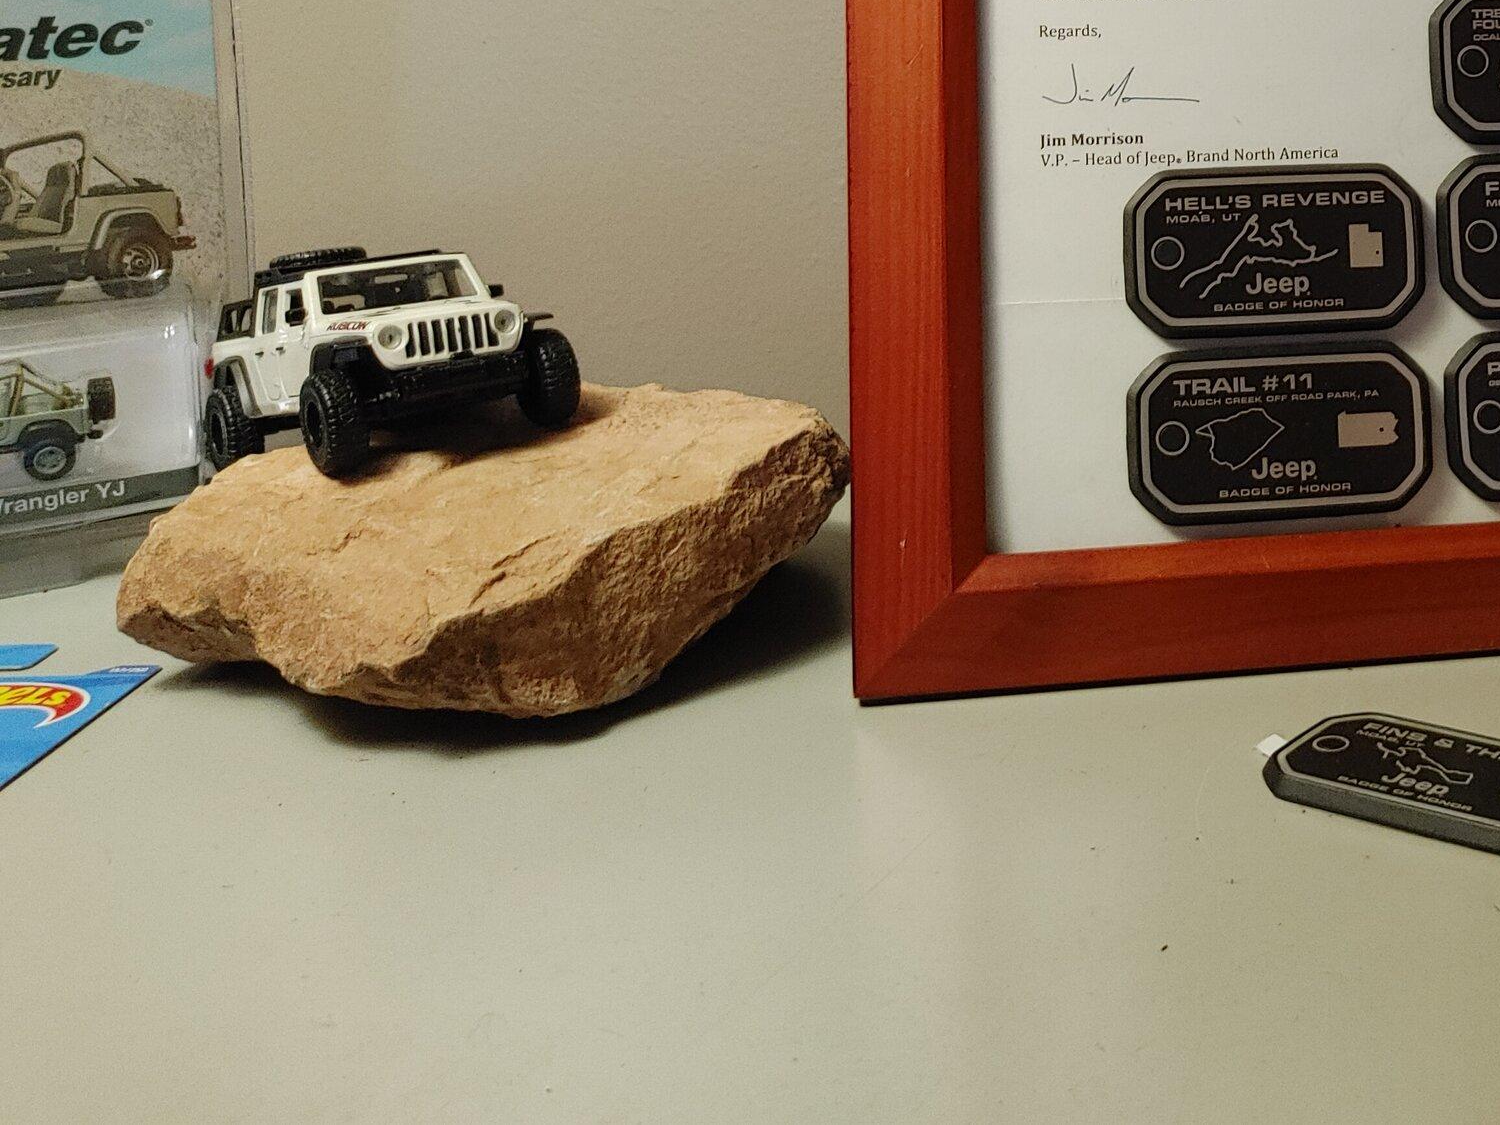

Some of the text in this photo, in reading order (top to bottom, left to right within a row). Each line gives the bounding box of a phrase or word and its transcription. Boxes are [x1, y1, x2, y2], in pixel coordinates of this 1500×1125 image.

[1038, 23, 1102, 41] Regards,
[1039, 131, 1144, 151] Jim Morrison
[1040, 153, 1069, 167] V.P.
[1085, 151, 1122, 166] Head
[1125, 150, 1143, 165] of
[1186, 148, 1230, 163] Brand
[1233, 146, 1276, 162] North
[1279, 146, 1339, 161] America
[1165, 190, 1386, 211] HELL'S REVENGE
[1166, 212, 1241, 224] MOAB, UT
[1213, 298, 1344, 312] BADGE OF HONOR
[1173, 373, 1313, 396] TRAIL #11
[1173, 389, 1379, 407] RAUSCH CREEK OFF ROAD PARK, PA
[95, 481, 125, 498] YJ
[1219, 482, 1351, 498] BADGE OF HONOR
[1363, 722, 1428, 743] FINS
